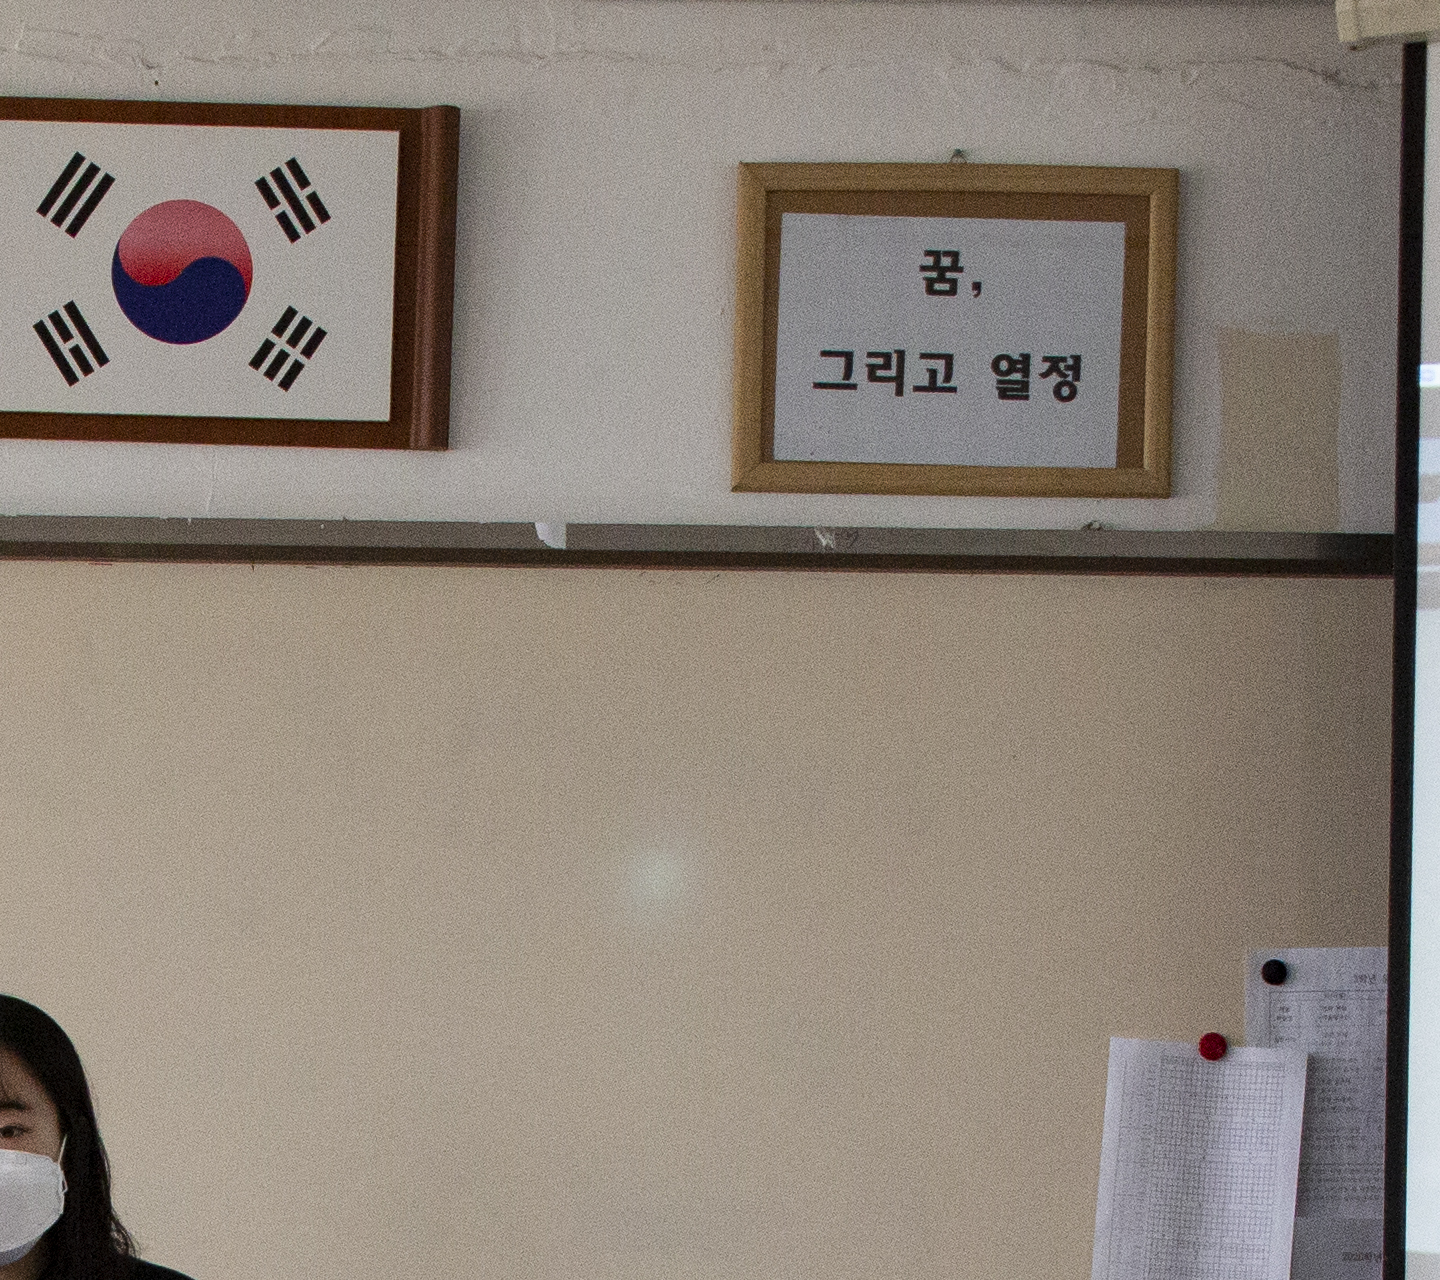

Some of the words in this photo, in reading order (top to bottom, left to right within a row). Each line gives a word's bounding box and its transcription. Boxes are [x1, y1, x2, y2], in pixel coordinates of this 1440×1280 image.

[919, 249, 983, 298] 꿈,
[812, 349, 959, 398] 그리고
[990, 353, 1083, 402] 열정
